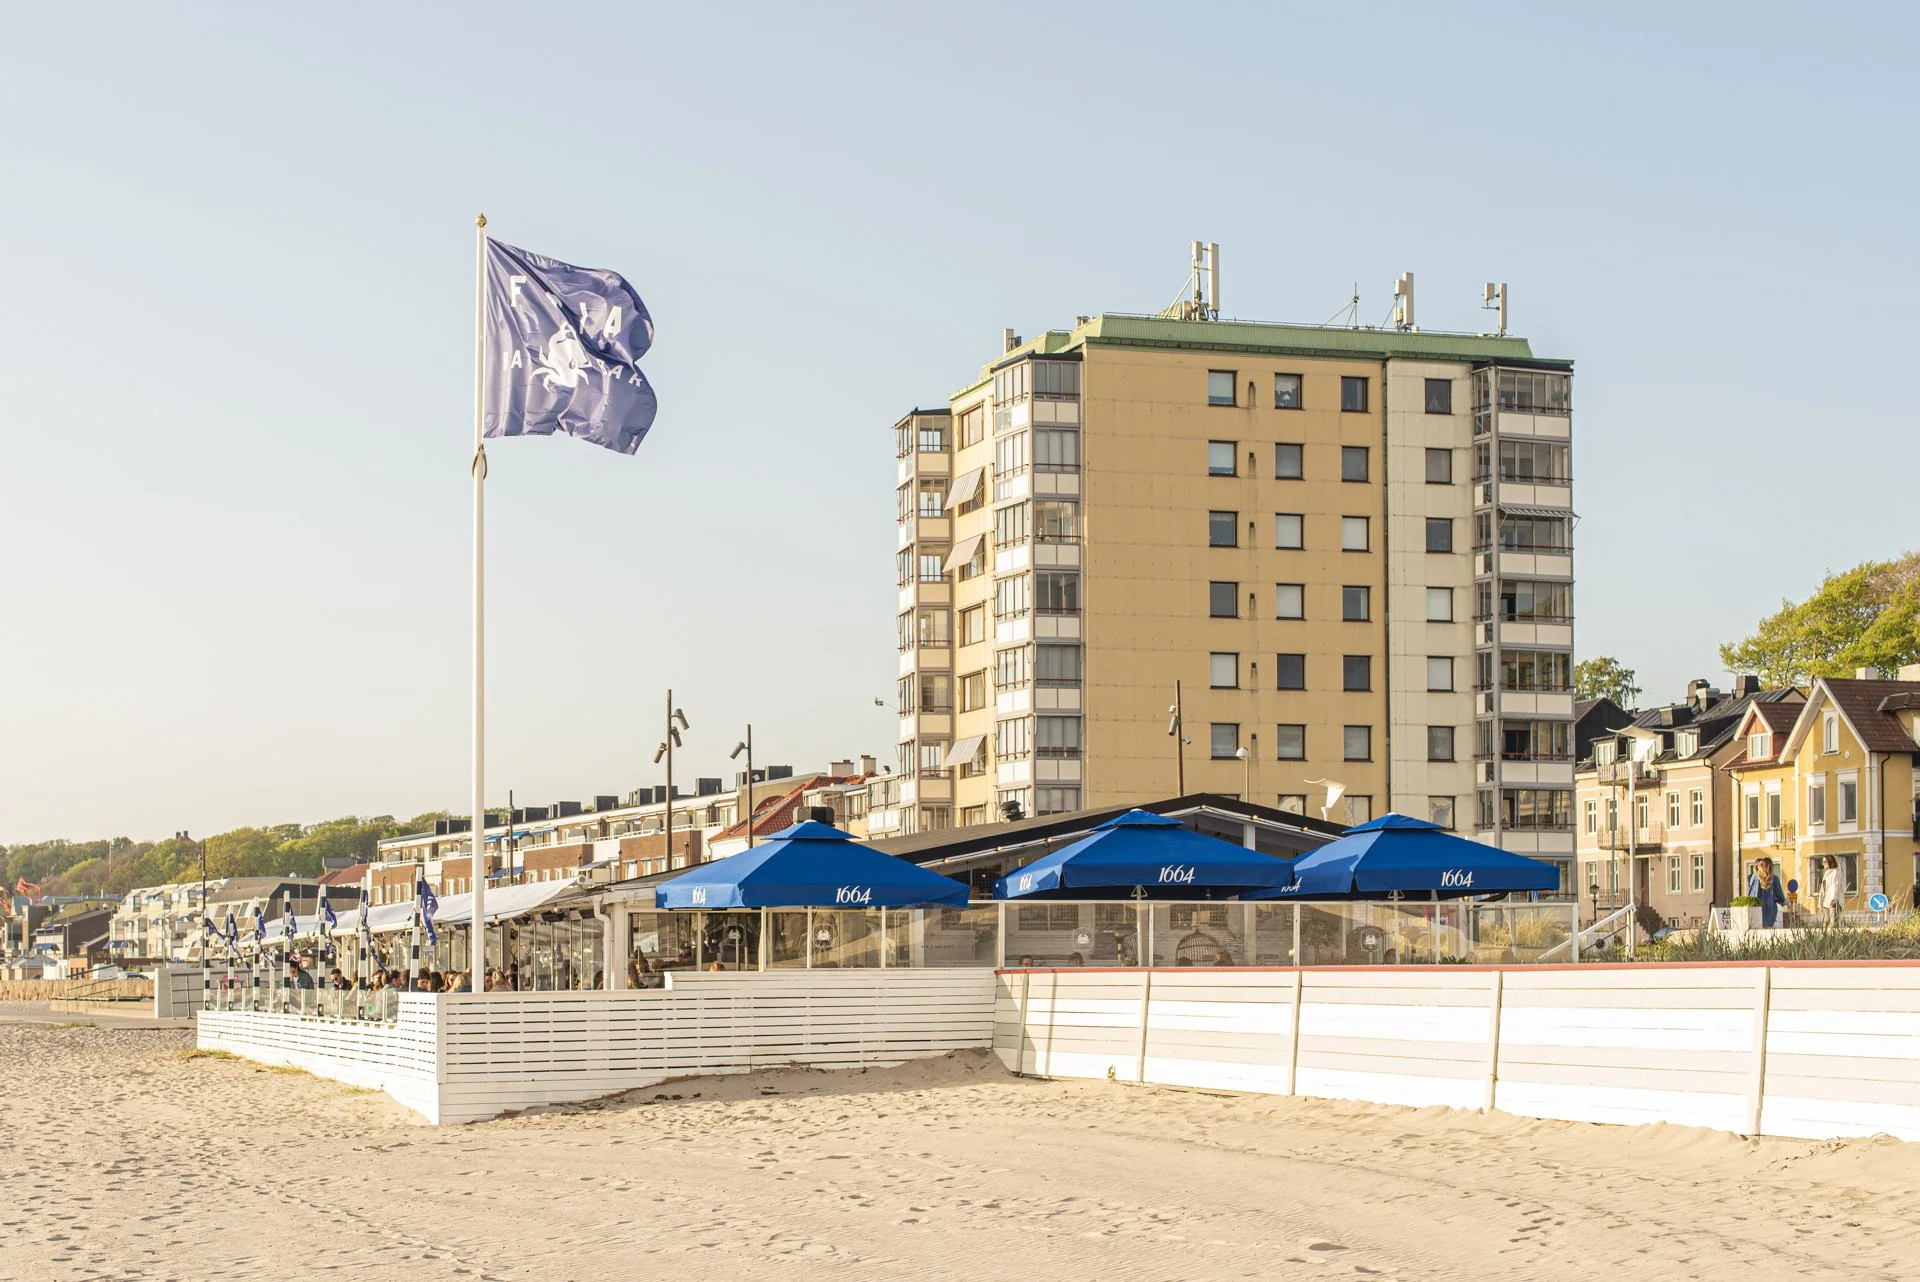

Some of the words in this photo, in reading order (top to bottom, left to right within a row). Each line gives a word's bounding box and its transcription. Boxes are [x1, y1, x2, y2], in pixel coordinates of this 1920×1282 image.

[1158, 864, 1196, 884] 1664
[1441, 869, 1474, 888] 1664
[835, 885, 872, 905] 1664
